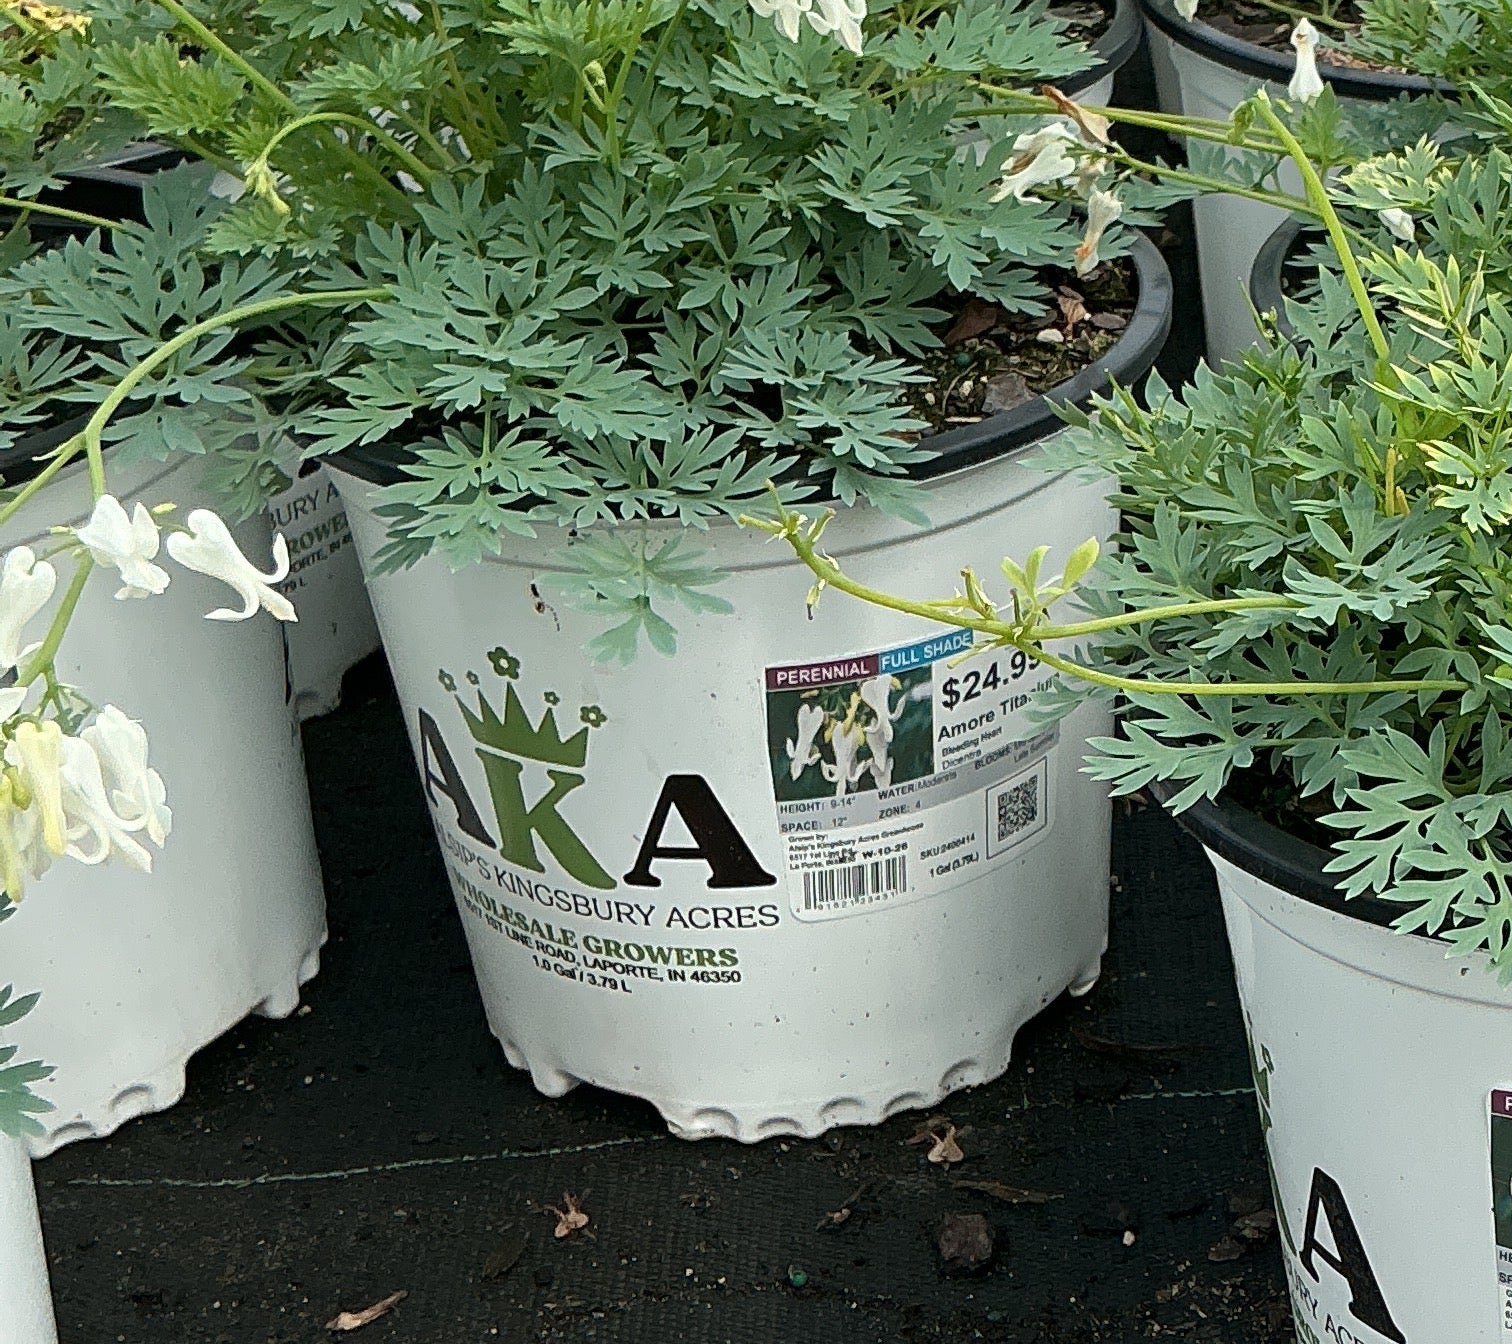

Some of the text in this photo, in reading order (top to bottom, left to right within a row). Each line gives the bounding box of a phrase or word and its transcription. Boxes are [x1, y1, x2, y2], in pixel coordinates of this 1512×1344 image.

[777, 632, 972, 685] PERENNIAL FULL SHADE
[938, 710, 995, 742] Amore
[419, 708, 777, 890] AKA
[780, 802, 825, 814] HEIGHT:
[453, 866, 739, 967] WHOLESALE GROWERS
[494, 866, 655, 927] KINGSBURY
[666, 905, 779, 928] ACRES
[533, 954, 551, 971] 1.0
[554, 962, 577, 980] Gal
[588, 972, 618, 990] 3.79
[622, 981, 632, 993] L
[584, 956, 663, 981] LAPORTE,
[669, 969, 685, 982] IN
[691, 970, 741, 983] 46350
